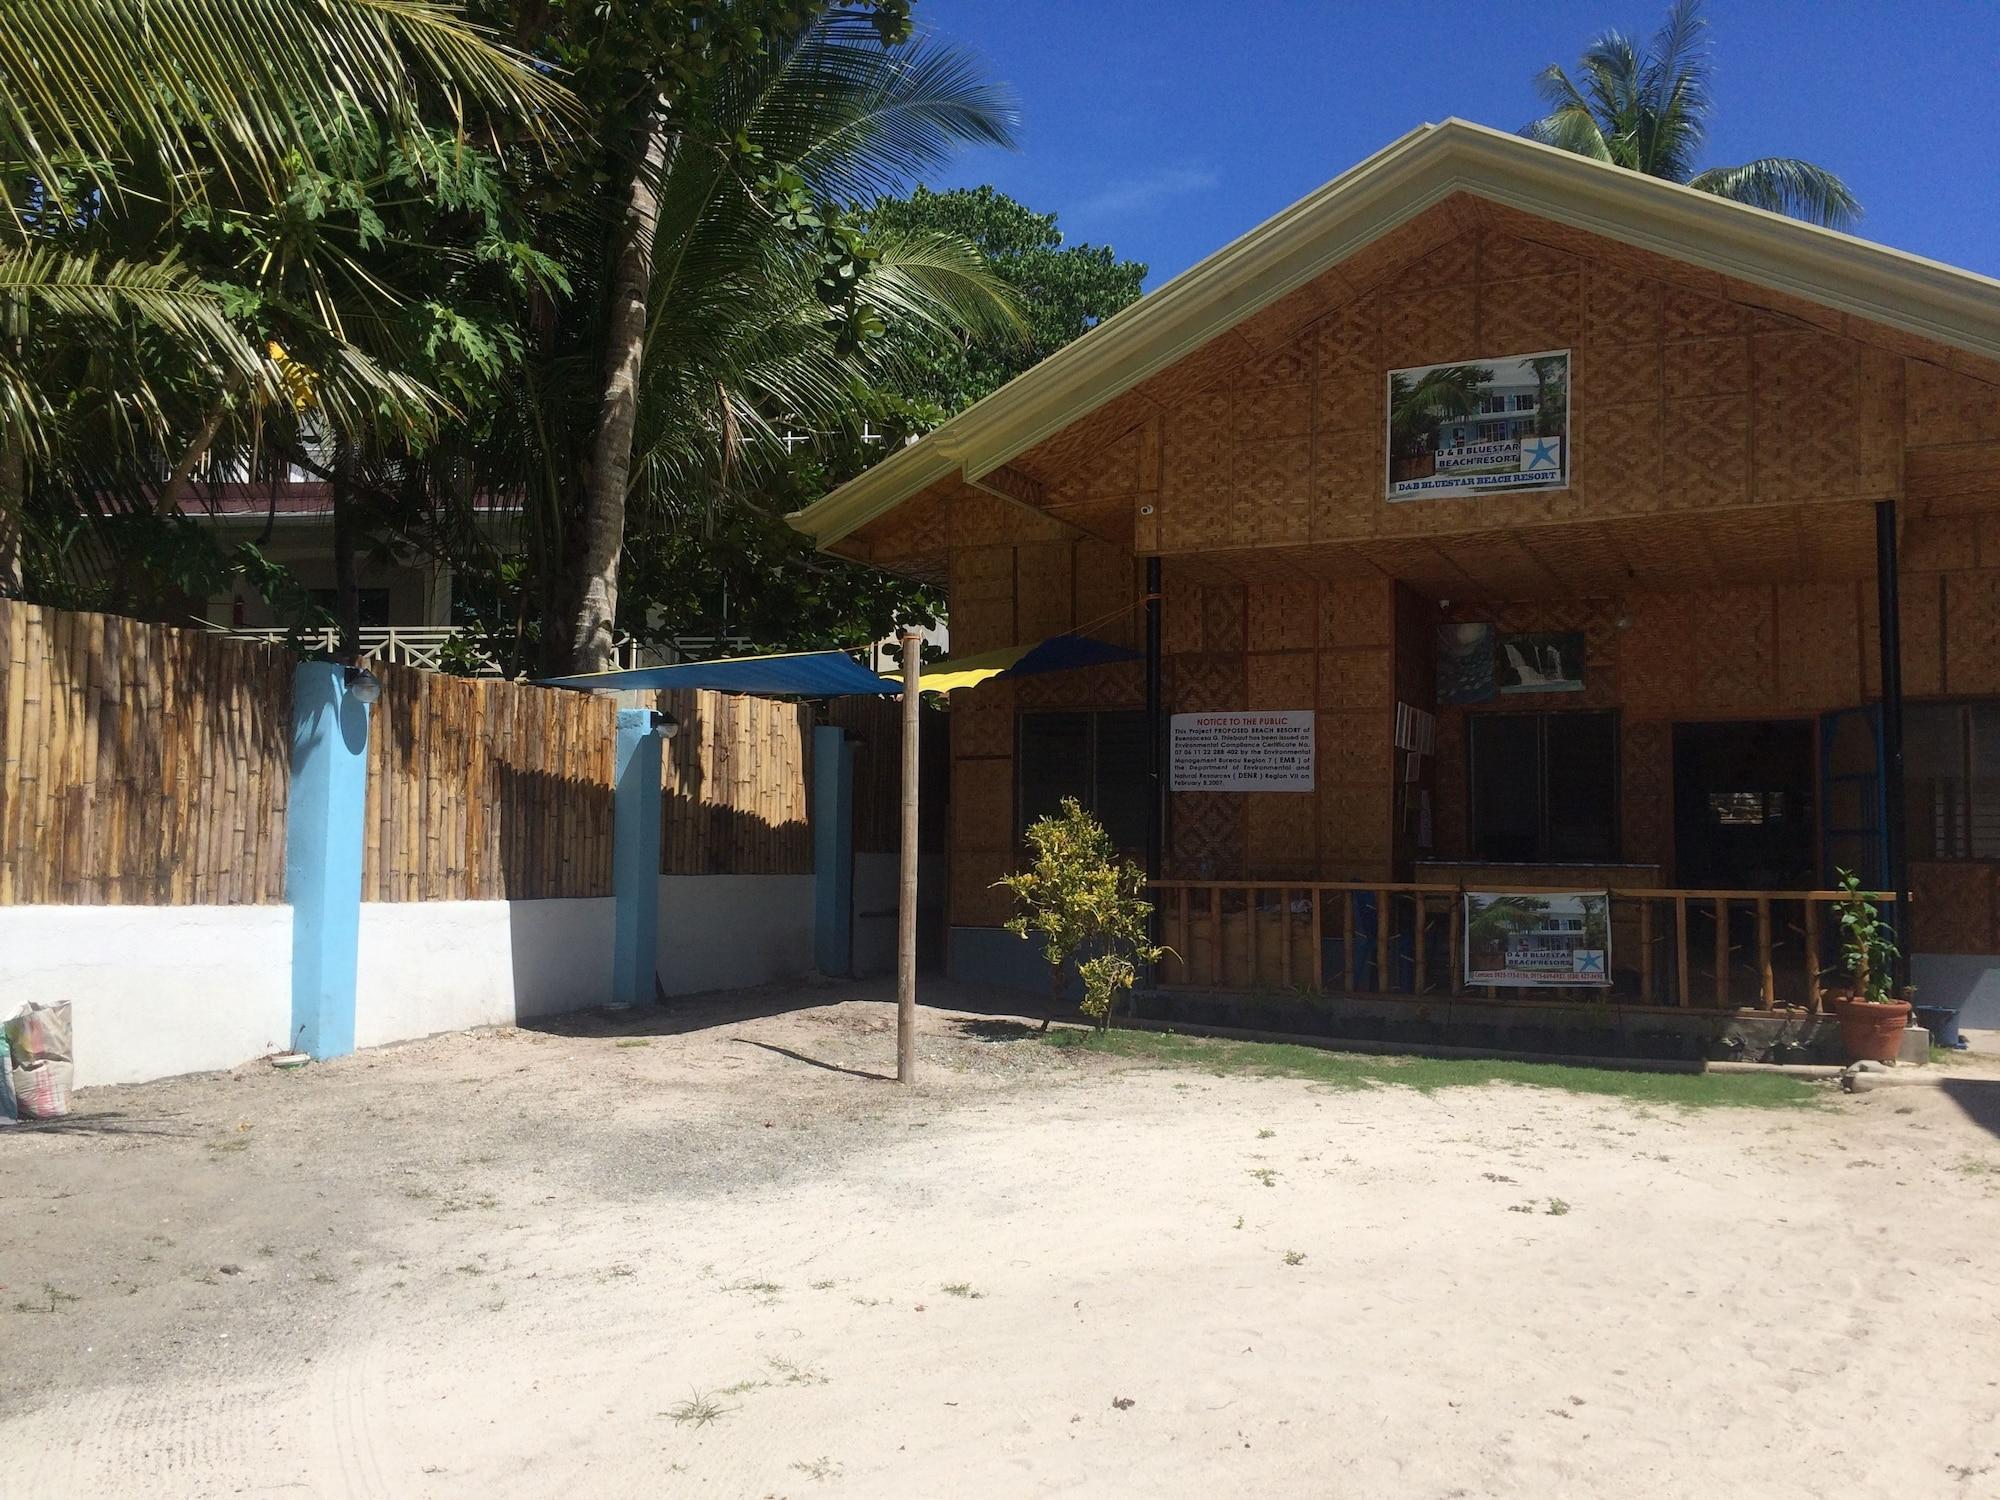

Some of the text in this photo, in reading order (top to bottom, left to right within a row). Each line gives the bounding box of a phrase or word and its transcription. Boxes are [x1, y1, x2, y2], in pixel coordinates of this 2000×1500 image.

[1466, 444, 1520, 454] BLUESTAR
[1438, 454, 1518, 468] BEACH RESORT
[1398, 472, 1557, 492] D&B BLUESTAR BEACH RESORT
